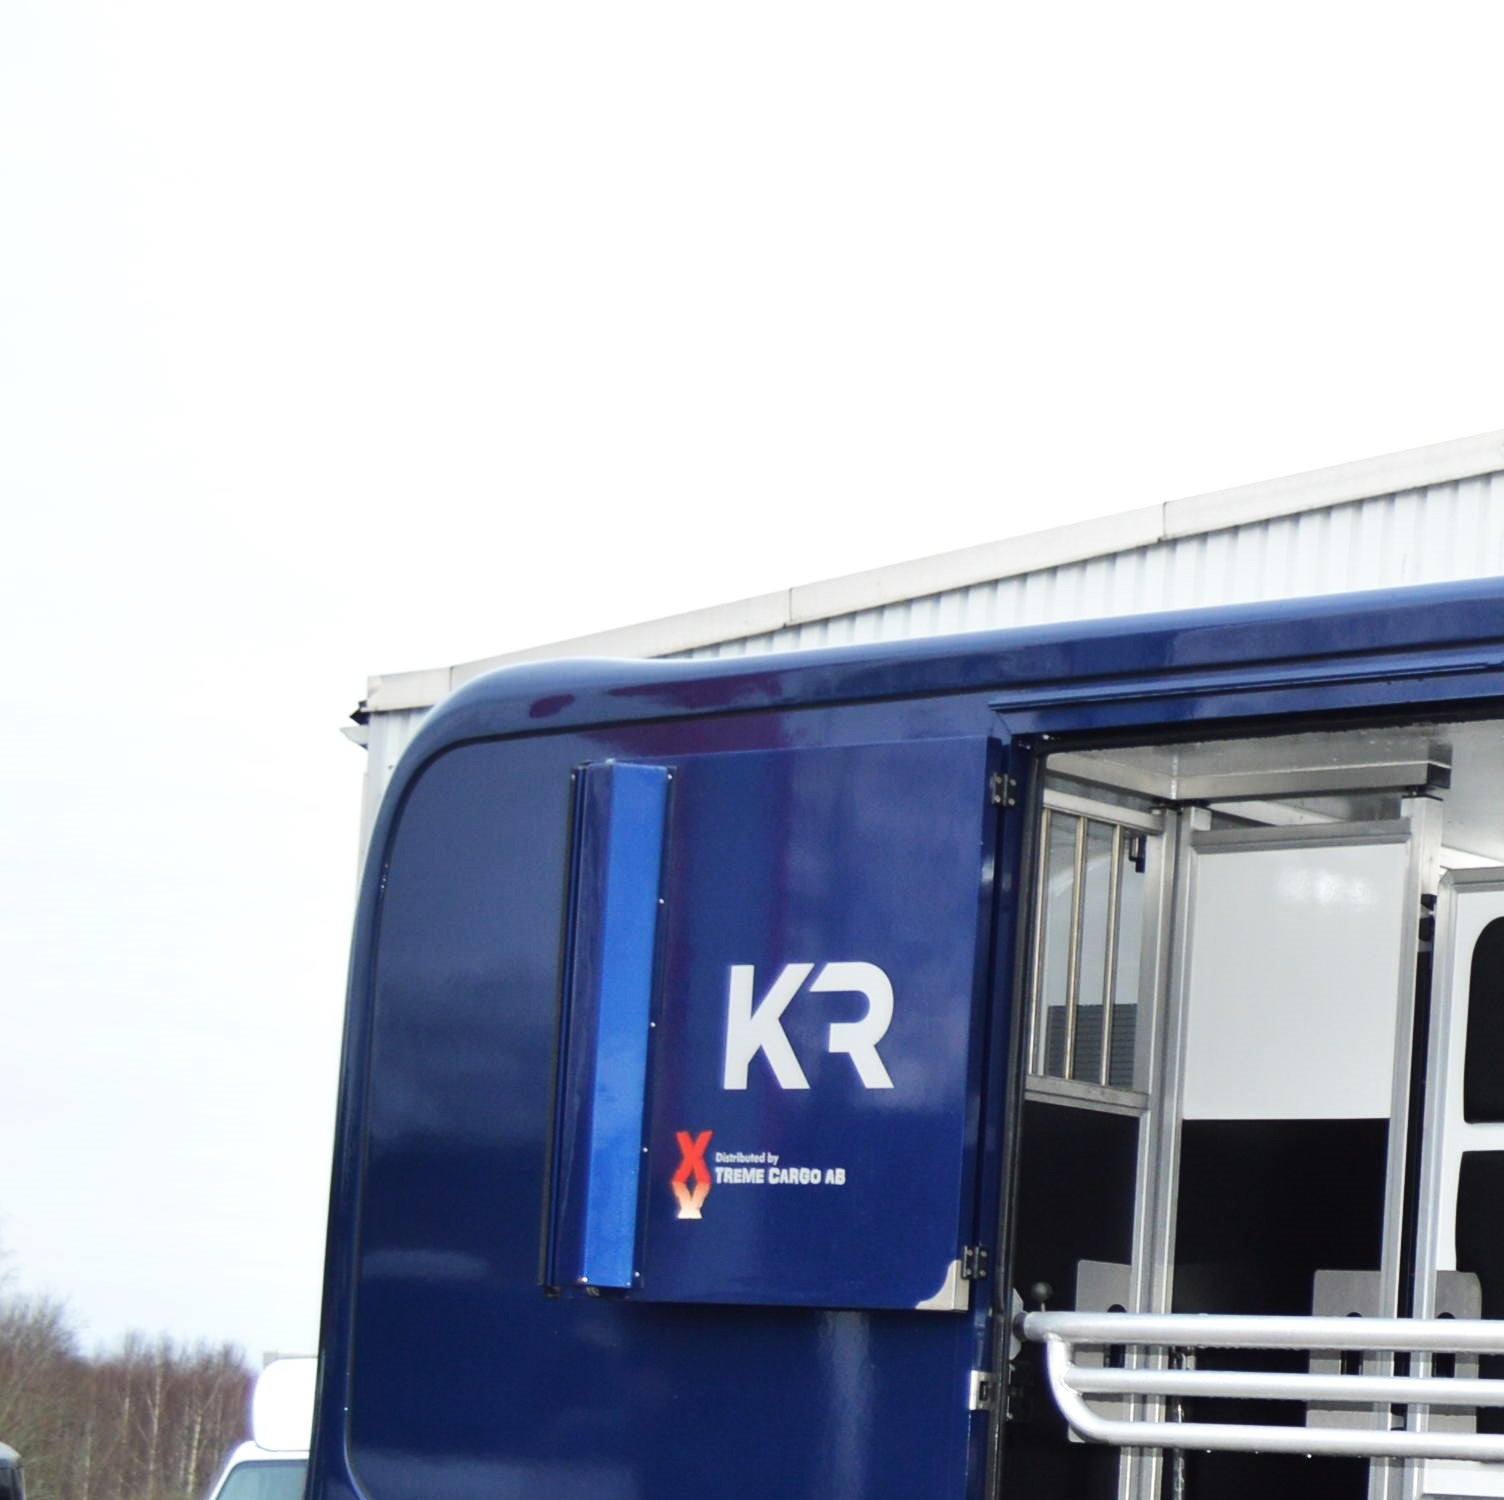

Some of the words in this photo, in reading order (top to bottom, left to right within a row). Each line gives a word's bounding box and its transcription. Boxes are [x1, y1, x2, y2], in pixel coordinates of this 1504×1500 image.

[724, 962, 894, 1089] KR
[715, 1152, 766, 1164] Distributed
[767, 1152, 779, 1165] by
[768, 1167, 822, 1185] CARGO
[825, 1168, 846, 1185] AB
